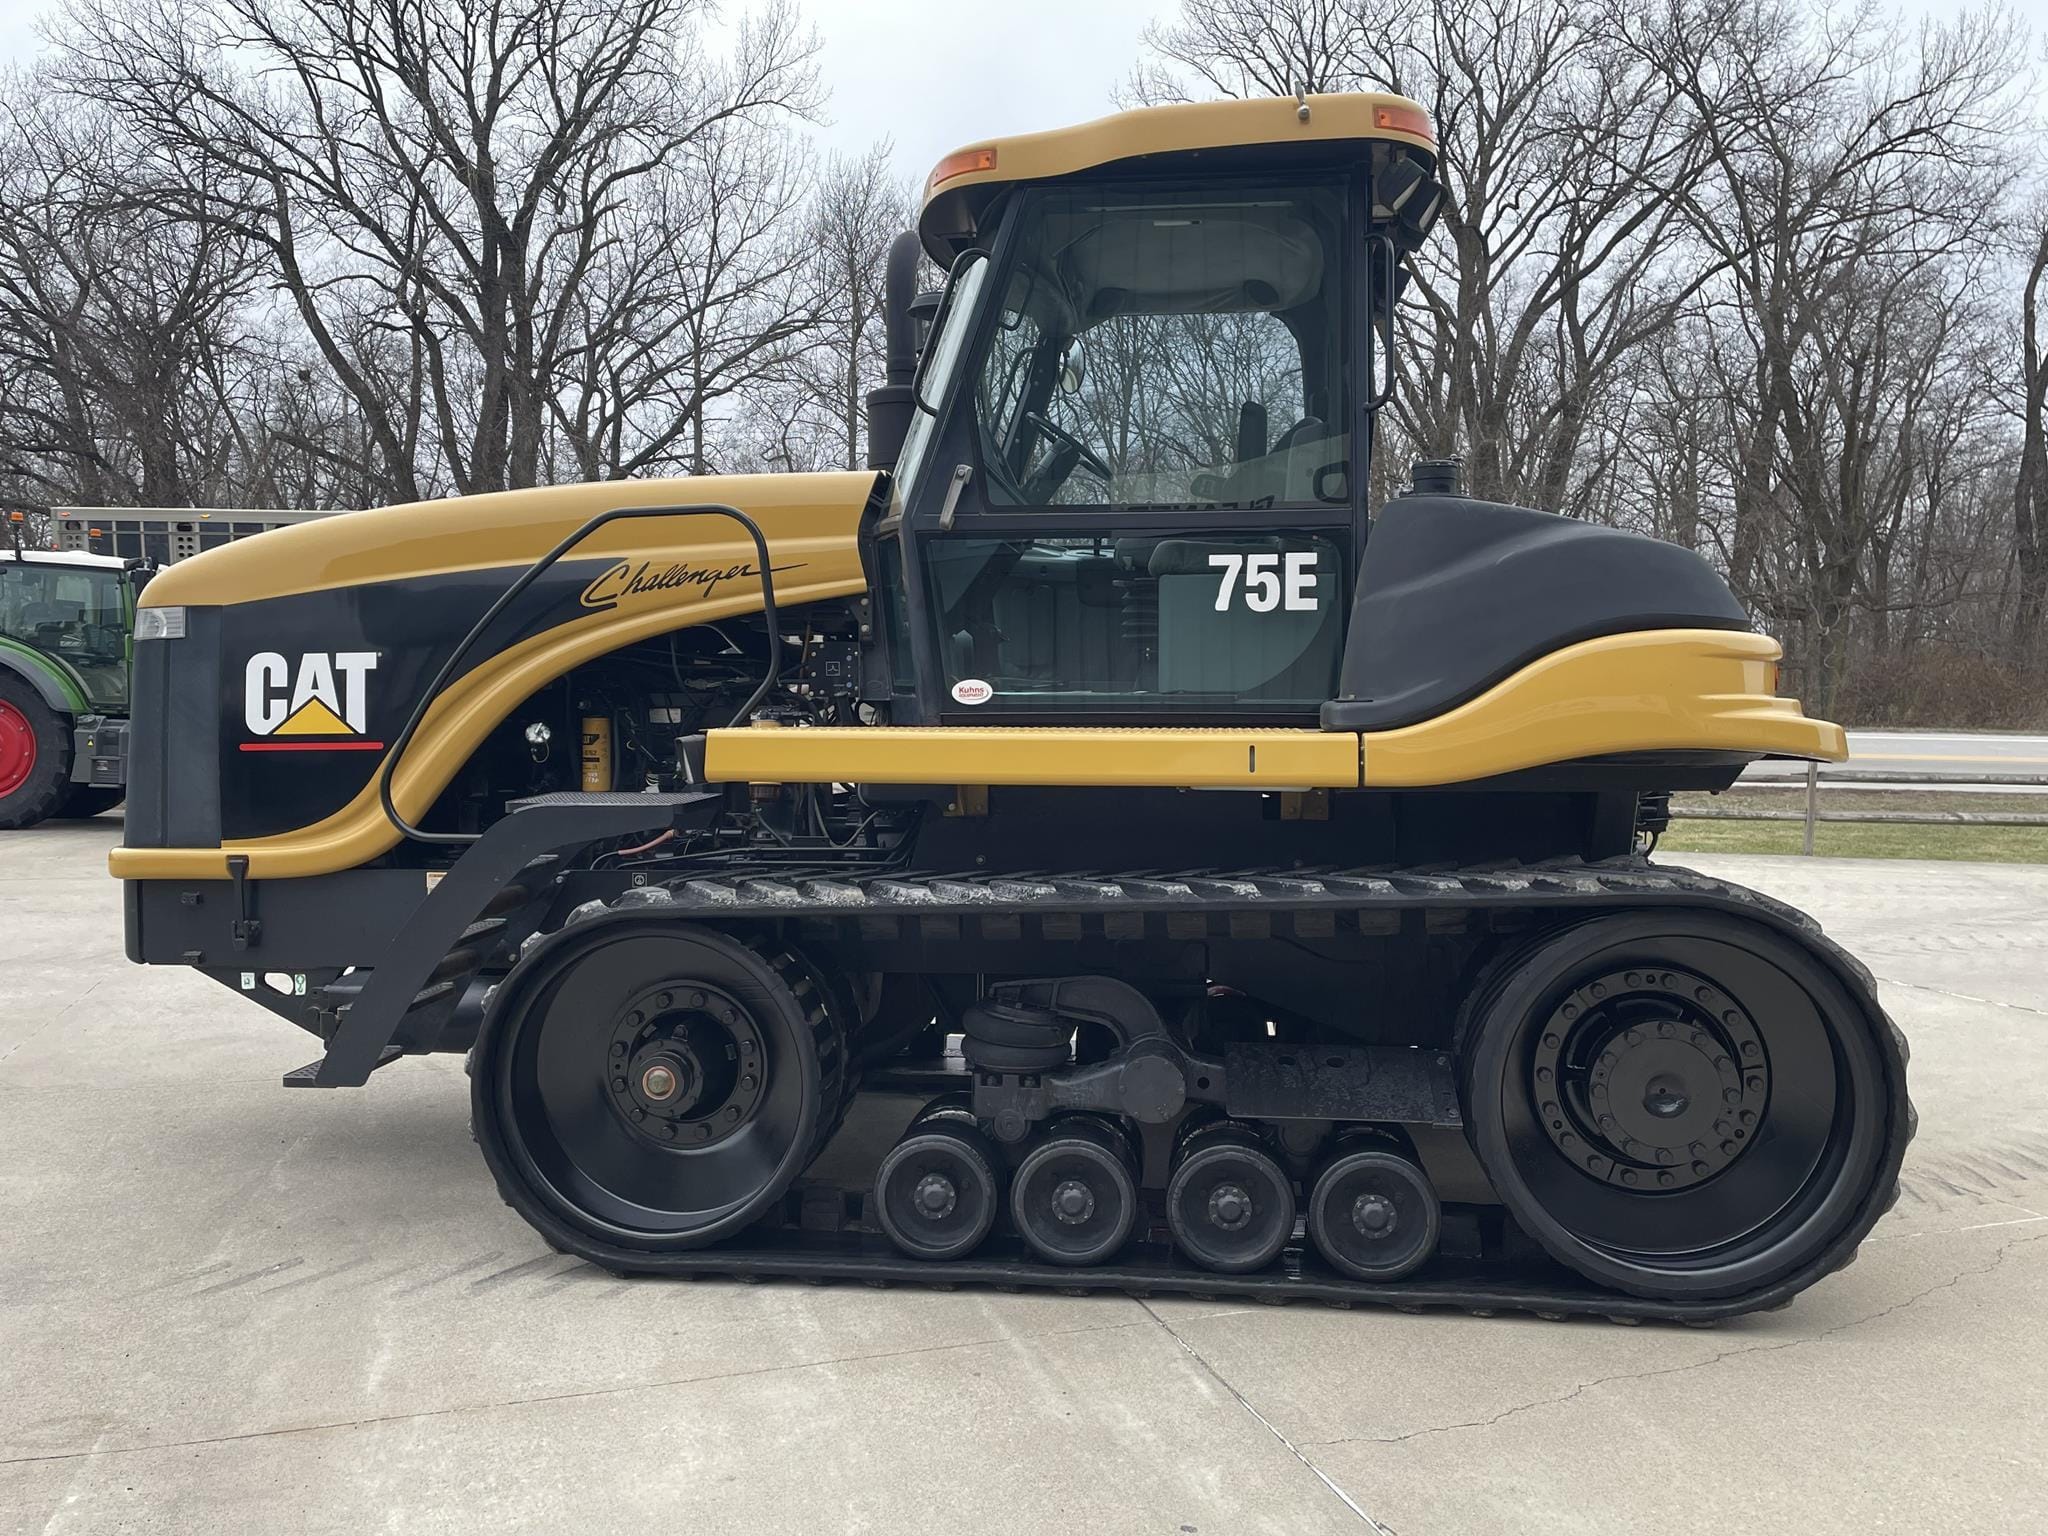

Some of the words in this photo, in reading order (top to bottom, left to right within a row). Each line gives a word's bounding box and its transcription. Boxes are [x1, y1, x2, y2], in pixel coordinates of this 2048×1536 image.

[582, 561, 808, 607] Challenger
[1208, 552, 1318, 612] 75E
[245, 651, 377, 735] CAT
[958, 686, 984, 694] Kuhns
